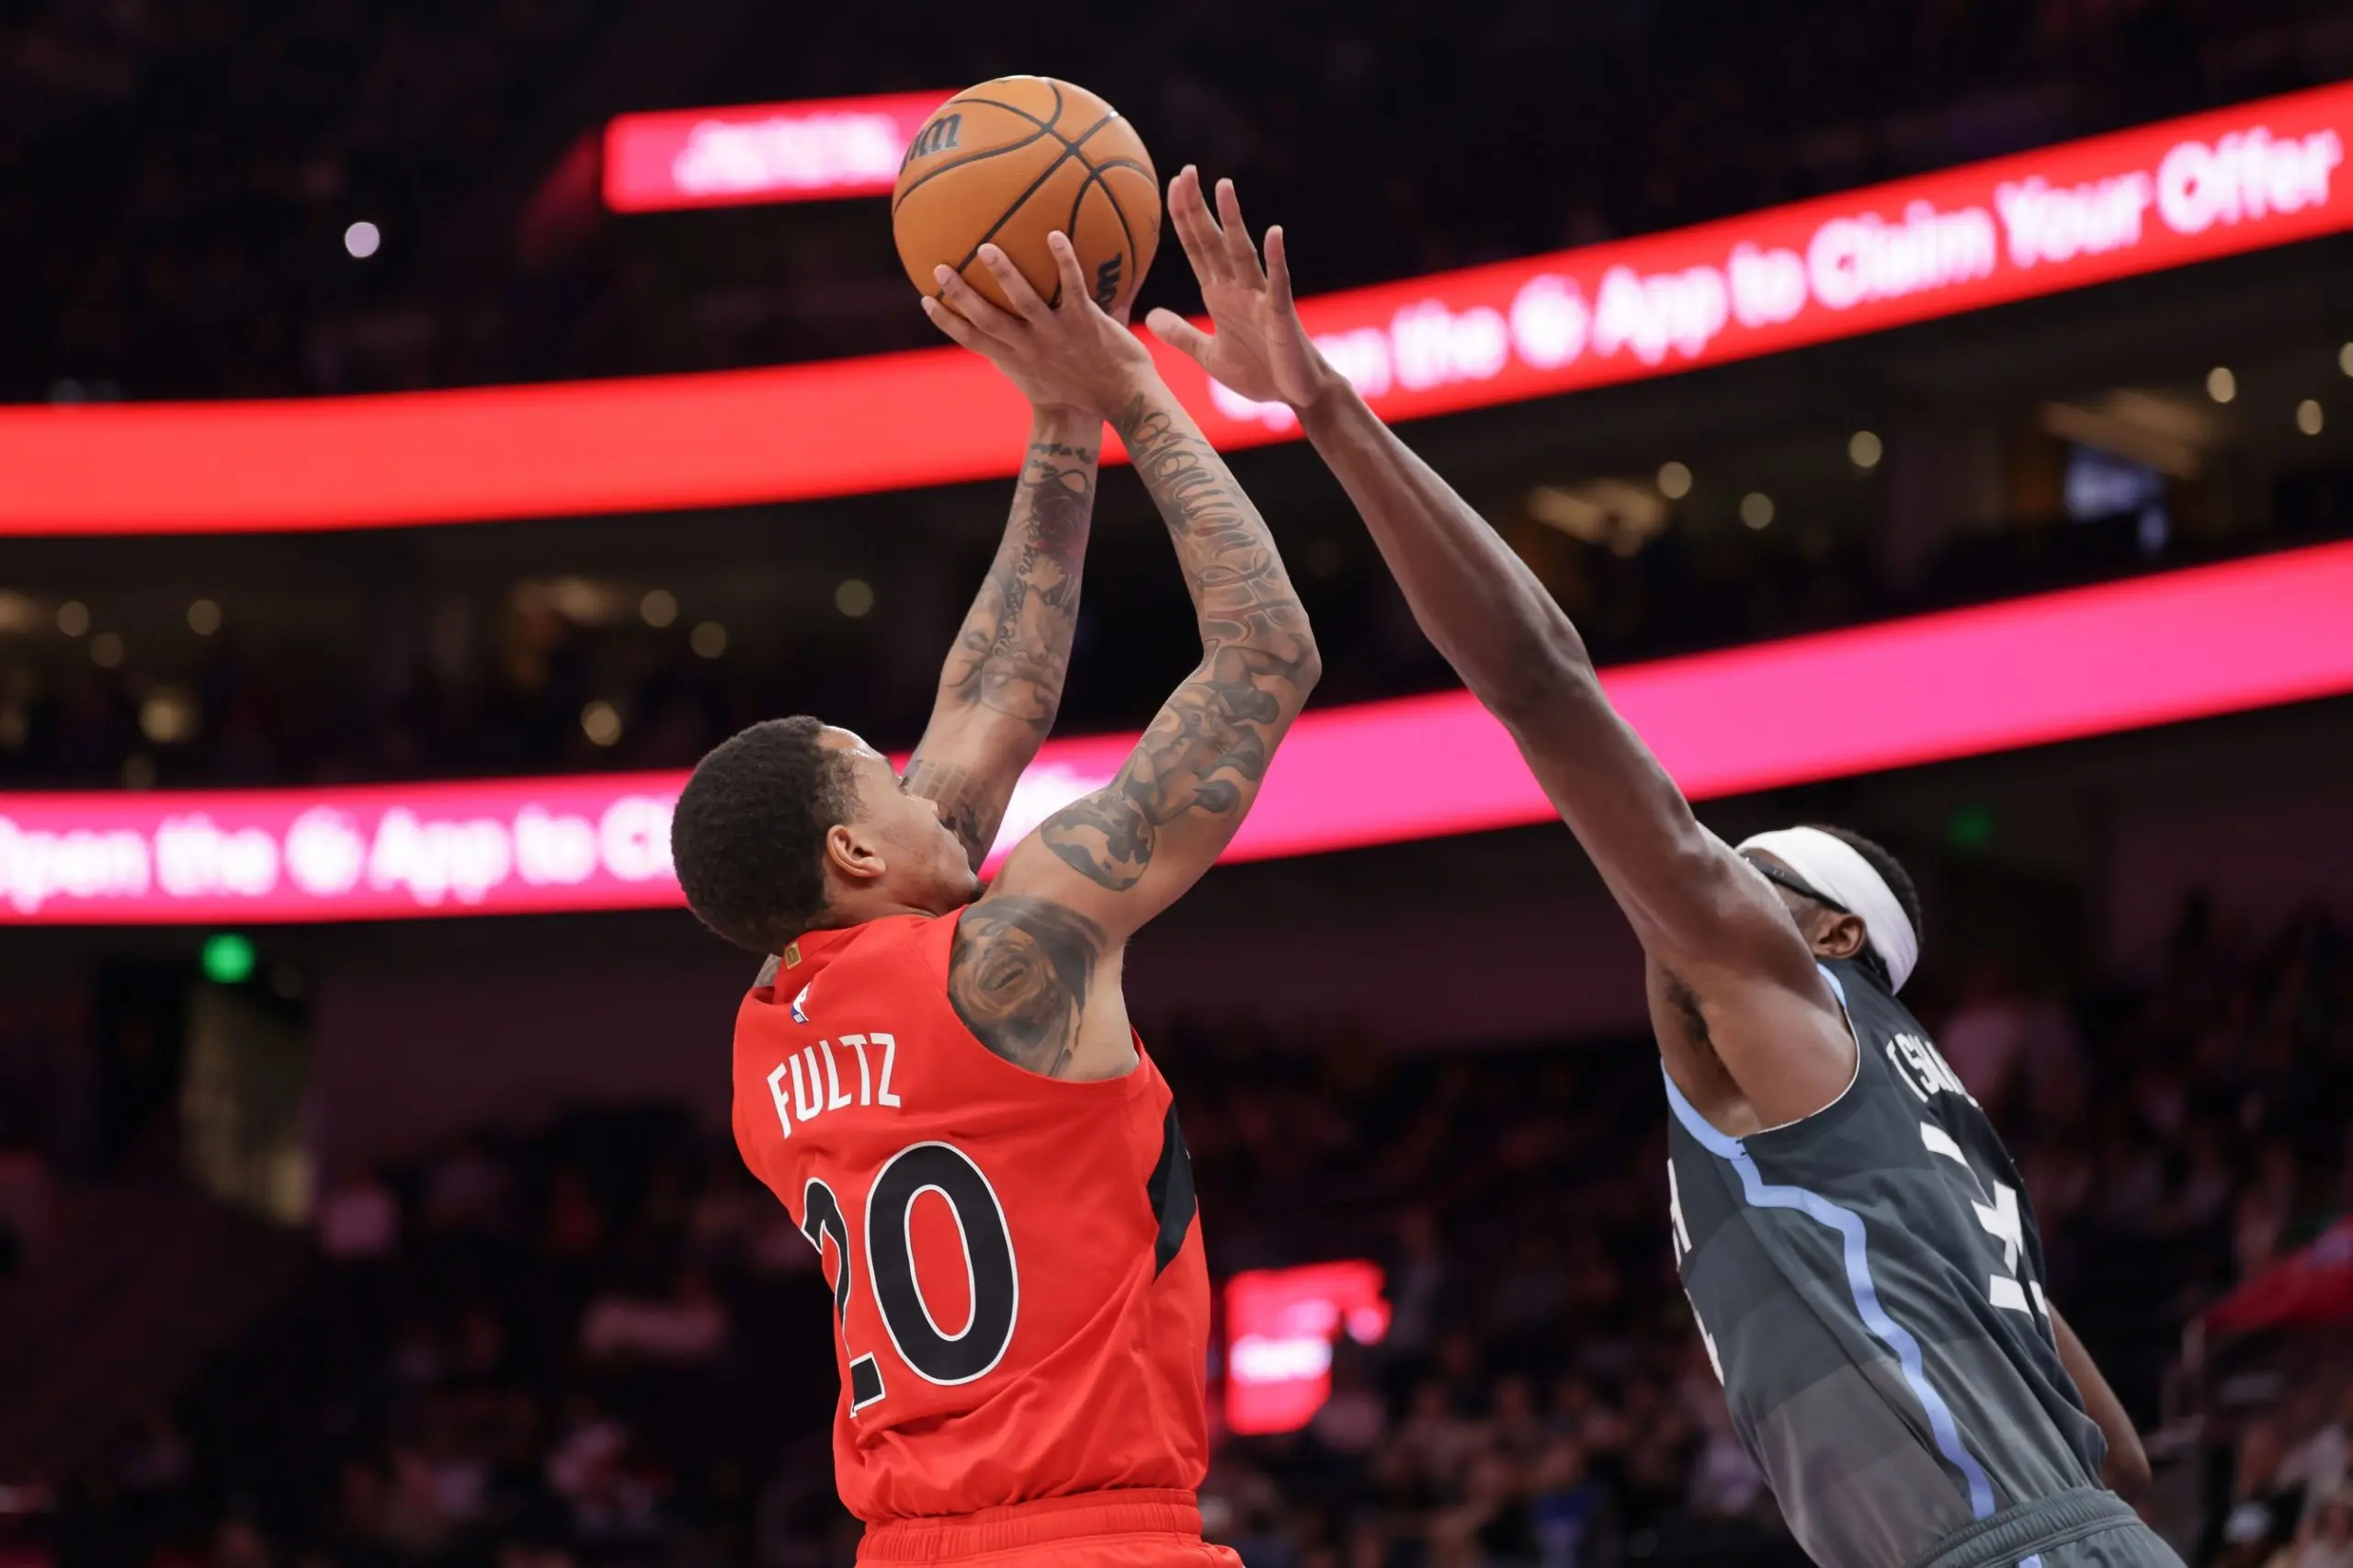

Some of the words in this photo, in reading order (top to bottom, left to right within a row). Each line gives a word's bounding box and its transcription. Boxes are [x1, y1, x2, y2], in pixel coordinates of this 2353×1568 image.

[1729, 240, 1809, 327] to
[2156, 126, 2343, 233] Offer
[767, 1033, 901, 1139] FULTZ
[801, 1141, 1018, 1418] 20
